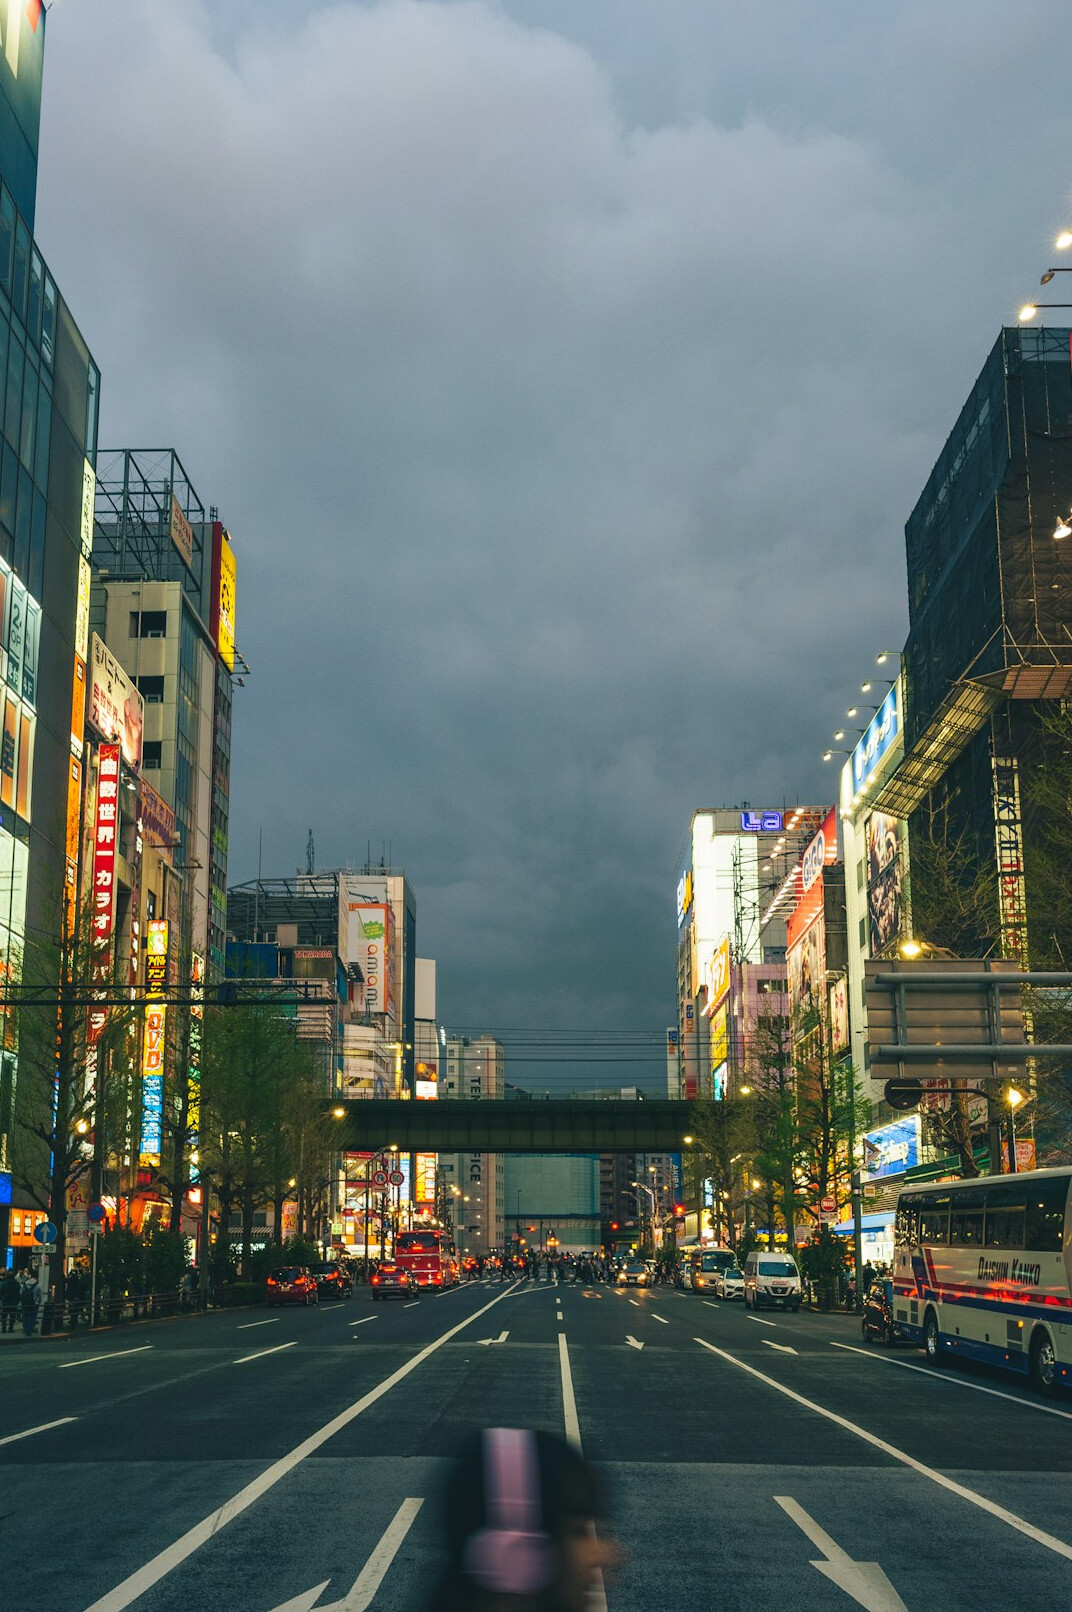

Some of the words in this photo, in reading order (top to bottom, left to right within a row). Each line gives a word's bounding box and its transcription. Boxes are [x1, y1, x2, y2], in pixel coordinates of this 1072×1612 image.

[148, 969, 165, 979] アニメ
[367, 943, 378, 1006] amiami
[145, 1011, 164, 1070] DVD
[978, 1256, 1009, 1282] DAISHIN
[1011, 1258, 1041, 1286] KANKO
